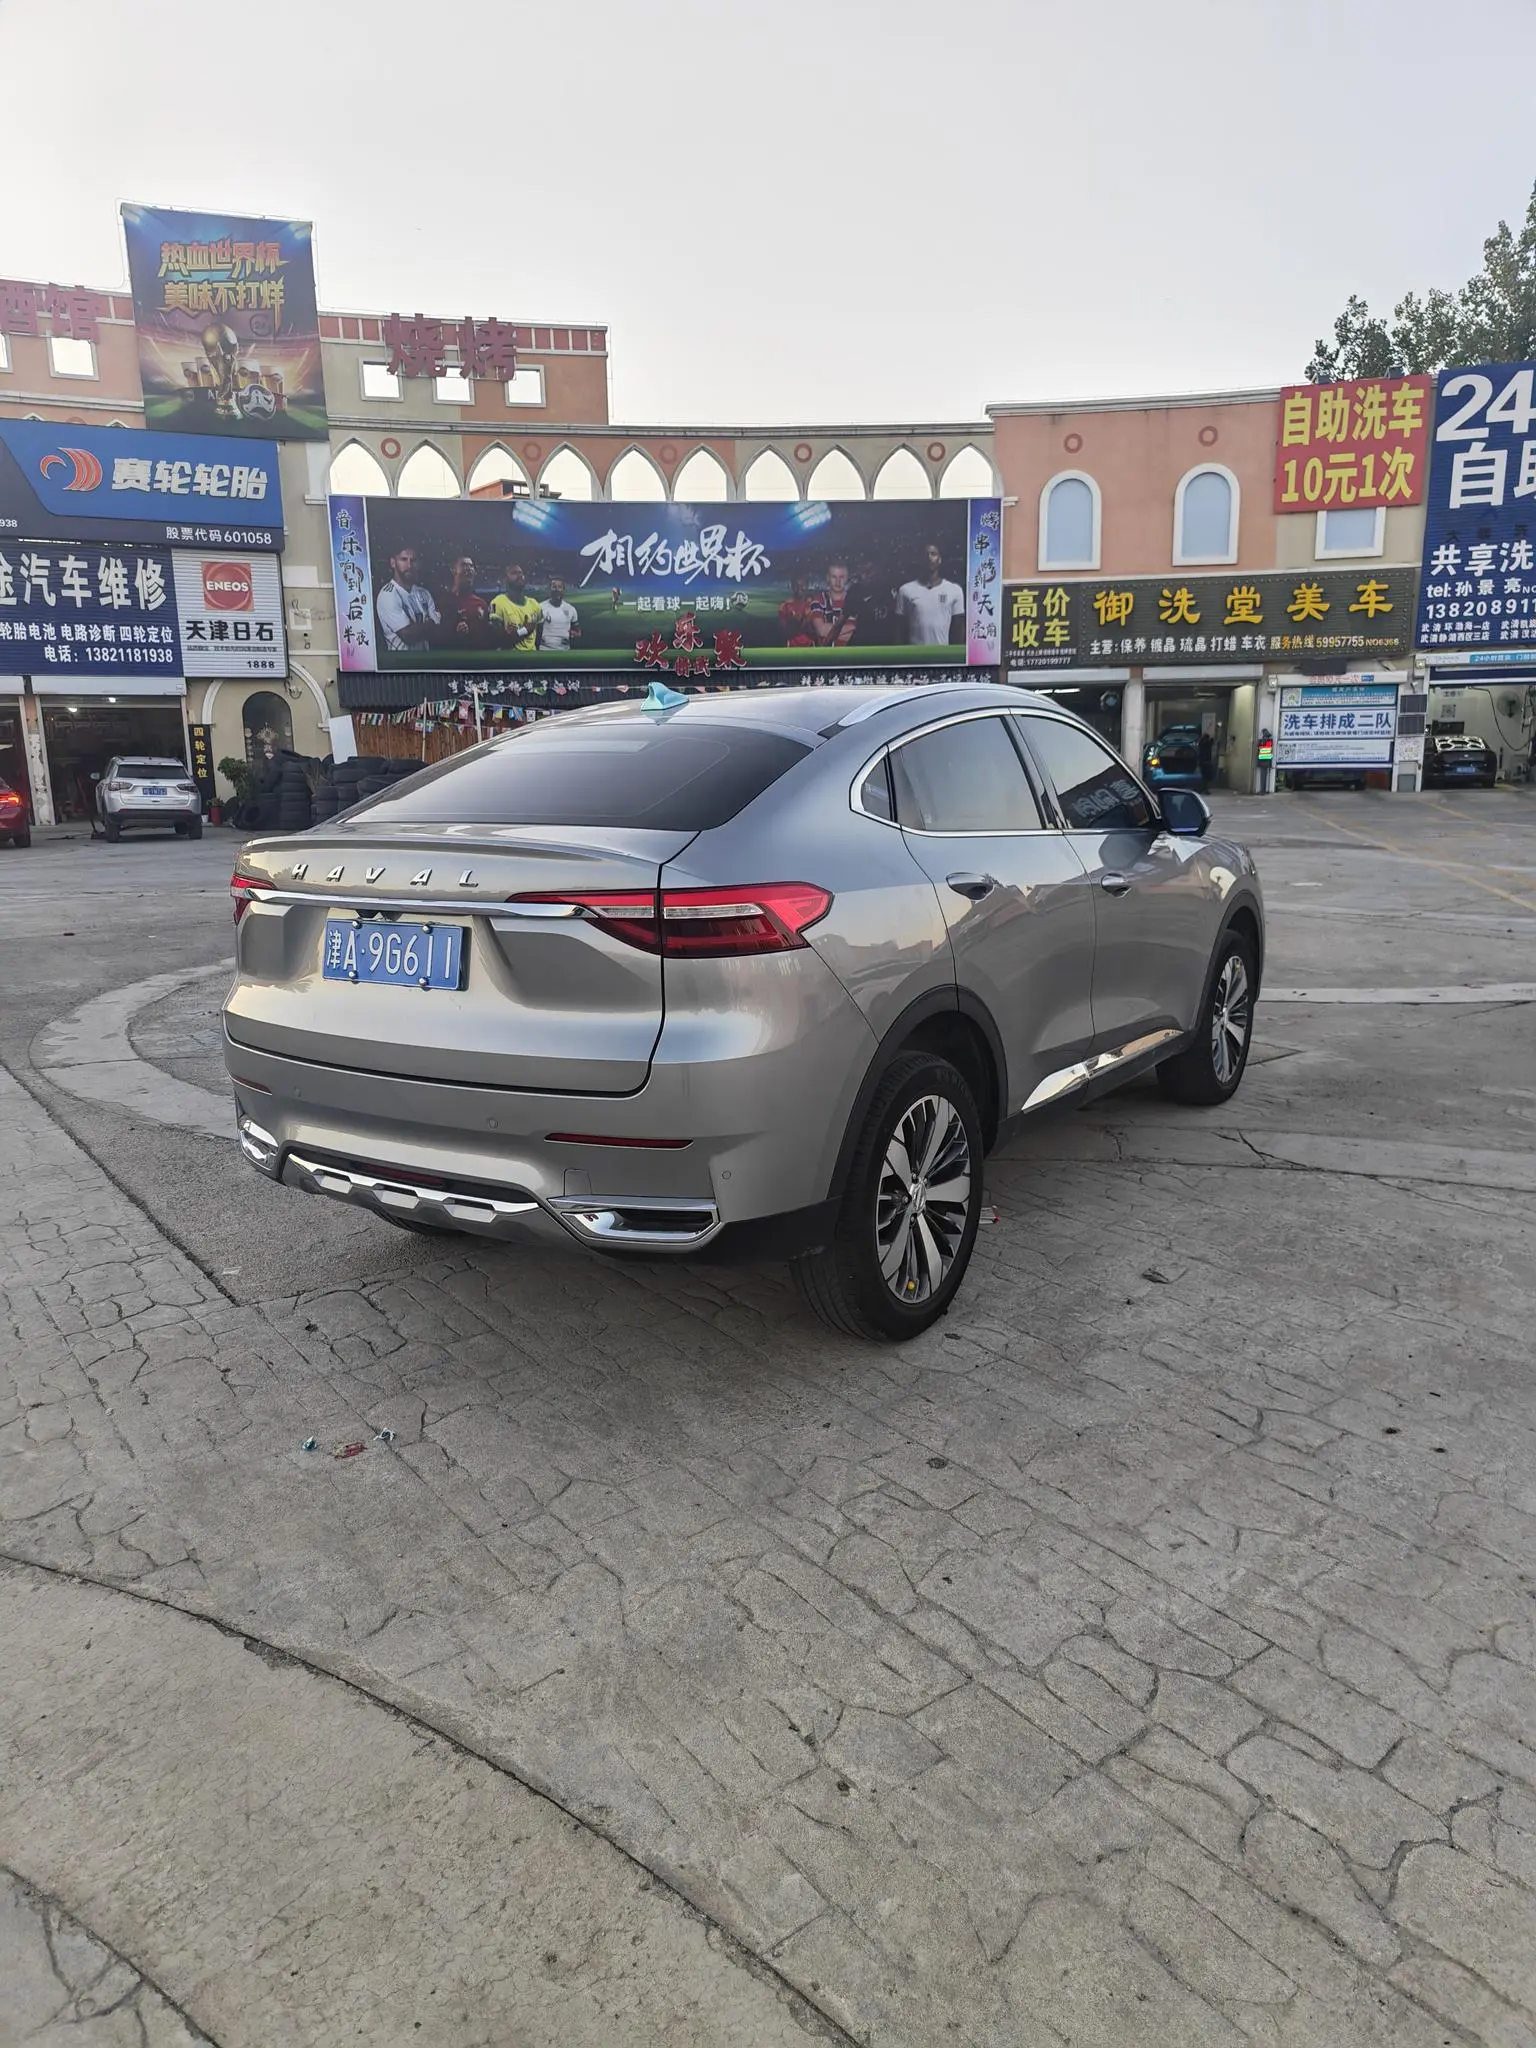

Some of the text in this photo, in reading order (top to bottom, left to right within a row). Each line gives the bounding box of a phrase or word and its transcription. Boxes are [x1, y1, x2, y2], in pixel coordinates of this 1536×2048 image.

[158, 236, 288, 278] 热血世界杯
[157, 276, 286, 334] 美味不打烊
[384, 313, 517, 382] 烧烤
[1282, 383, 1425, 448] 自助洗车
[1436, 370, 1536, 442] 24
[111, 457, 268, 500] 赛轮轮胎
[1281, 446, 1416, 505] 10元1次
[165, 526, 273, 545] 股票代码601058
[206, 580, 249, 592] ENEOS
[622, 596, 731, 611] 一起看球一起嗨!
[1011, 587, 1071, 618] 高价
[1093, 579, 1394, 627] 御洗堂美车
[60, 623, 116, 642] 电路诊断
[119, 625, 174, 644] 四轮定位
[185, 620, 275, 641] 天津日石
[1011, 618, 1071, 648] 收车
[1210, 636, 1237, 651] 打蜡
[1241, 635, 1266, 651] 车衣
[44, 645, 174, 663] 电话：13821181938
[247, 661, 275, 669] 1888
[1284, 713, 1392, 730] 洗车排成二队
[193, 727, 208, 778] 四轮定位
[290, 863, 479, 888] HAVAL
